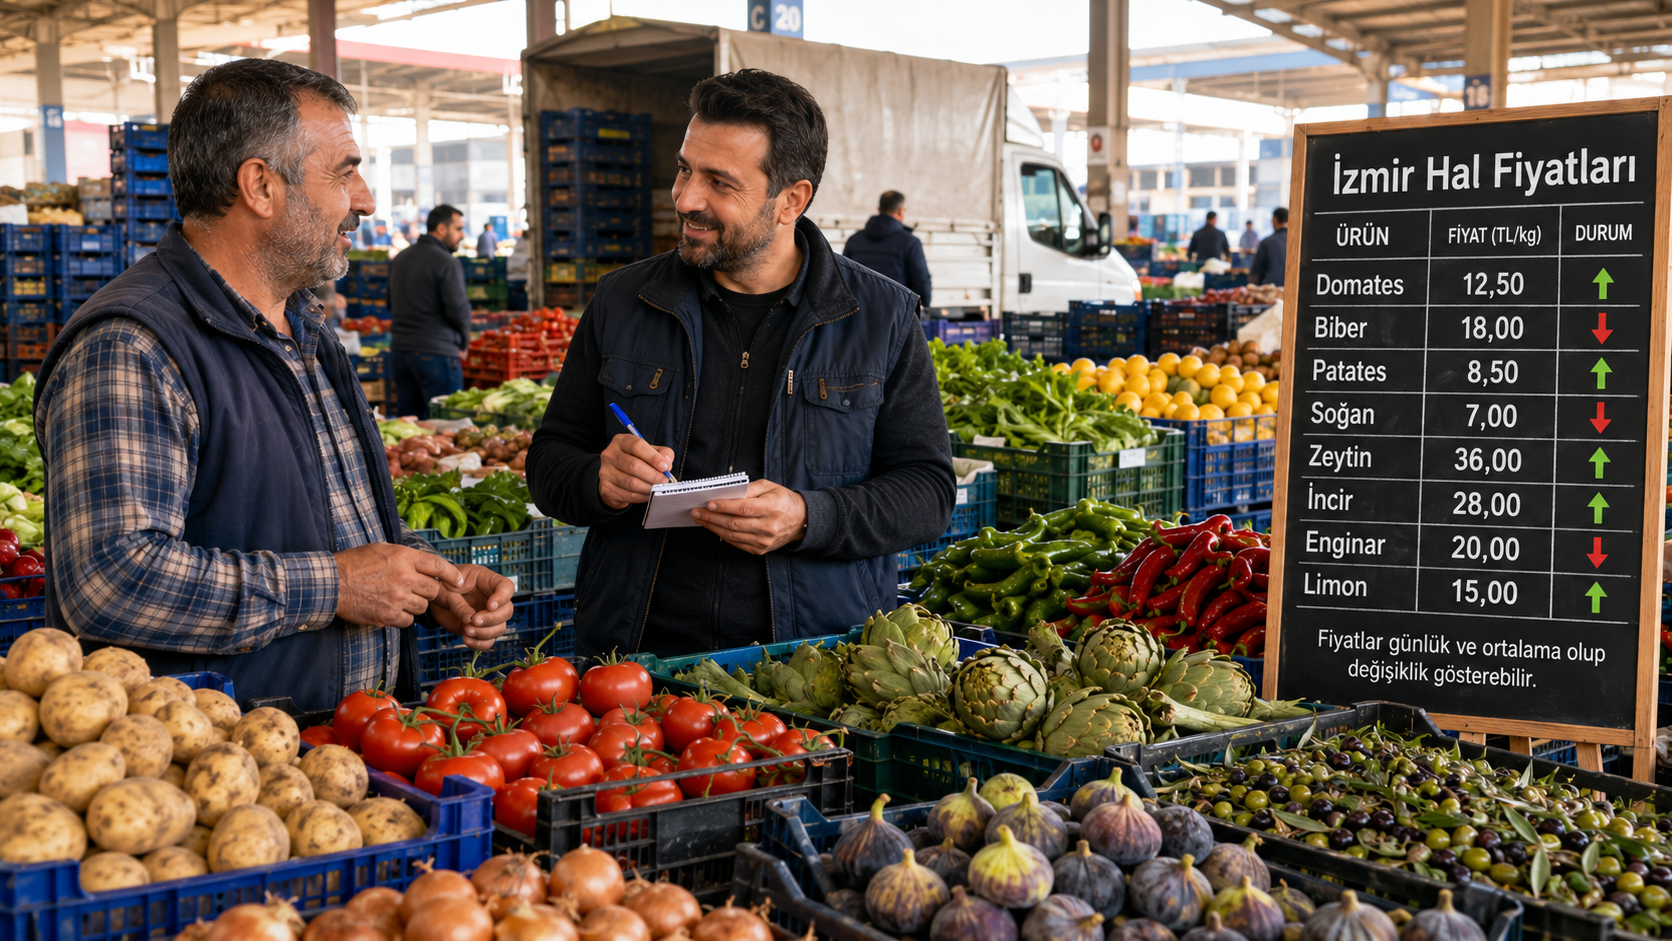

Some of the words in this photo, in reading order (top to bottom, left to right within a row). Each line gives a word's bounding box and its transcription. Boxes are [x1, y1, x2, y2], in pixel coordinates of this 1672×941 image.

[750, 4, 766, 30] C
[775, 3, 801, 32] 20
[1333, 152, 1415, 195] İzmir
[1426, 153, 1480, 191] Hal
[1494, 147, 1636, 197] Fiyatları
[1336, 222, 1389, 247] ÜRÜN
[1448, 223, 1488, 244] FİYAT
[1491, 225, 1542, 247] (TL/kg)
[1575, 223, 1633, 242] DURUM
[1316, 273, 1404, 296] Domates
[1463, 271, 1525, 299] 12,50
[1314, 315, 1368, 339] Biber
[1461, 315, 1524, 344] 18,00
[1312, 358, 1387, 382] Patates
[1467, 359, 1519, 388] 8,50
[1310, 401, 1375, 430] Soğan
[1465, 403, 1518, 432] 7,00
[1308, 444, 1372, 473] Zeytin
[1454, 447, 1522, 476] 36,00
[1308, 481, 1354, 511] İncir
[1452, 491, 1521, 520] 28,00
[1305, 530, 1387, 559] Enginar
[1451, 534, 1520, 564] 20,00
[1304, 572, 1367, 597] Limon
[1452, 578, 1518, 608] 15,00
[1318, 629, 1384, 652] Fiyatlar
[1388, 633, 1451, 656] günlük
[1456, 640, 1477, 656] ve
[1482, 638, 1561, 660] ortalama
[1566, 641, 1606, 665] olup
[1348, 658, 1429, 684] değişiklik
[1433, 664, 1537, 688] gösterebilir.
